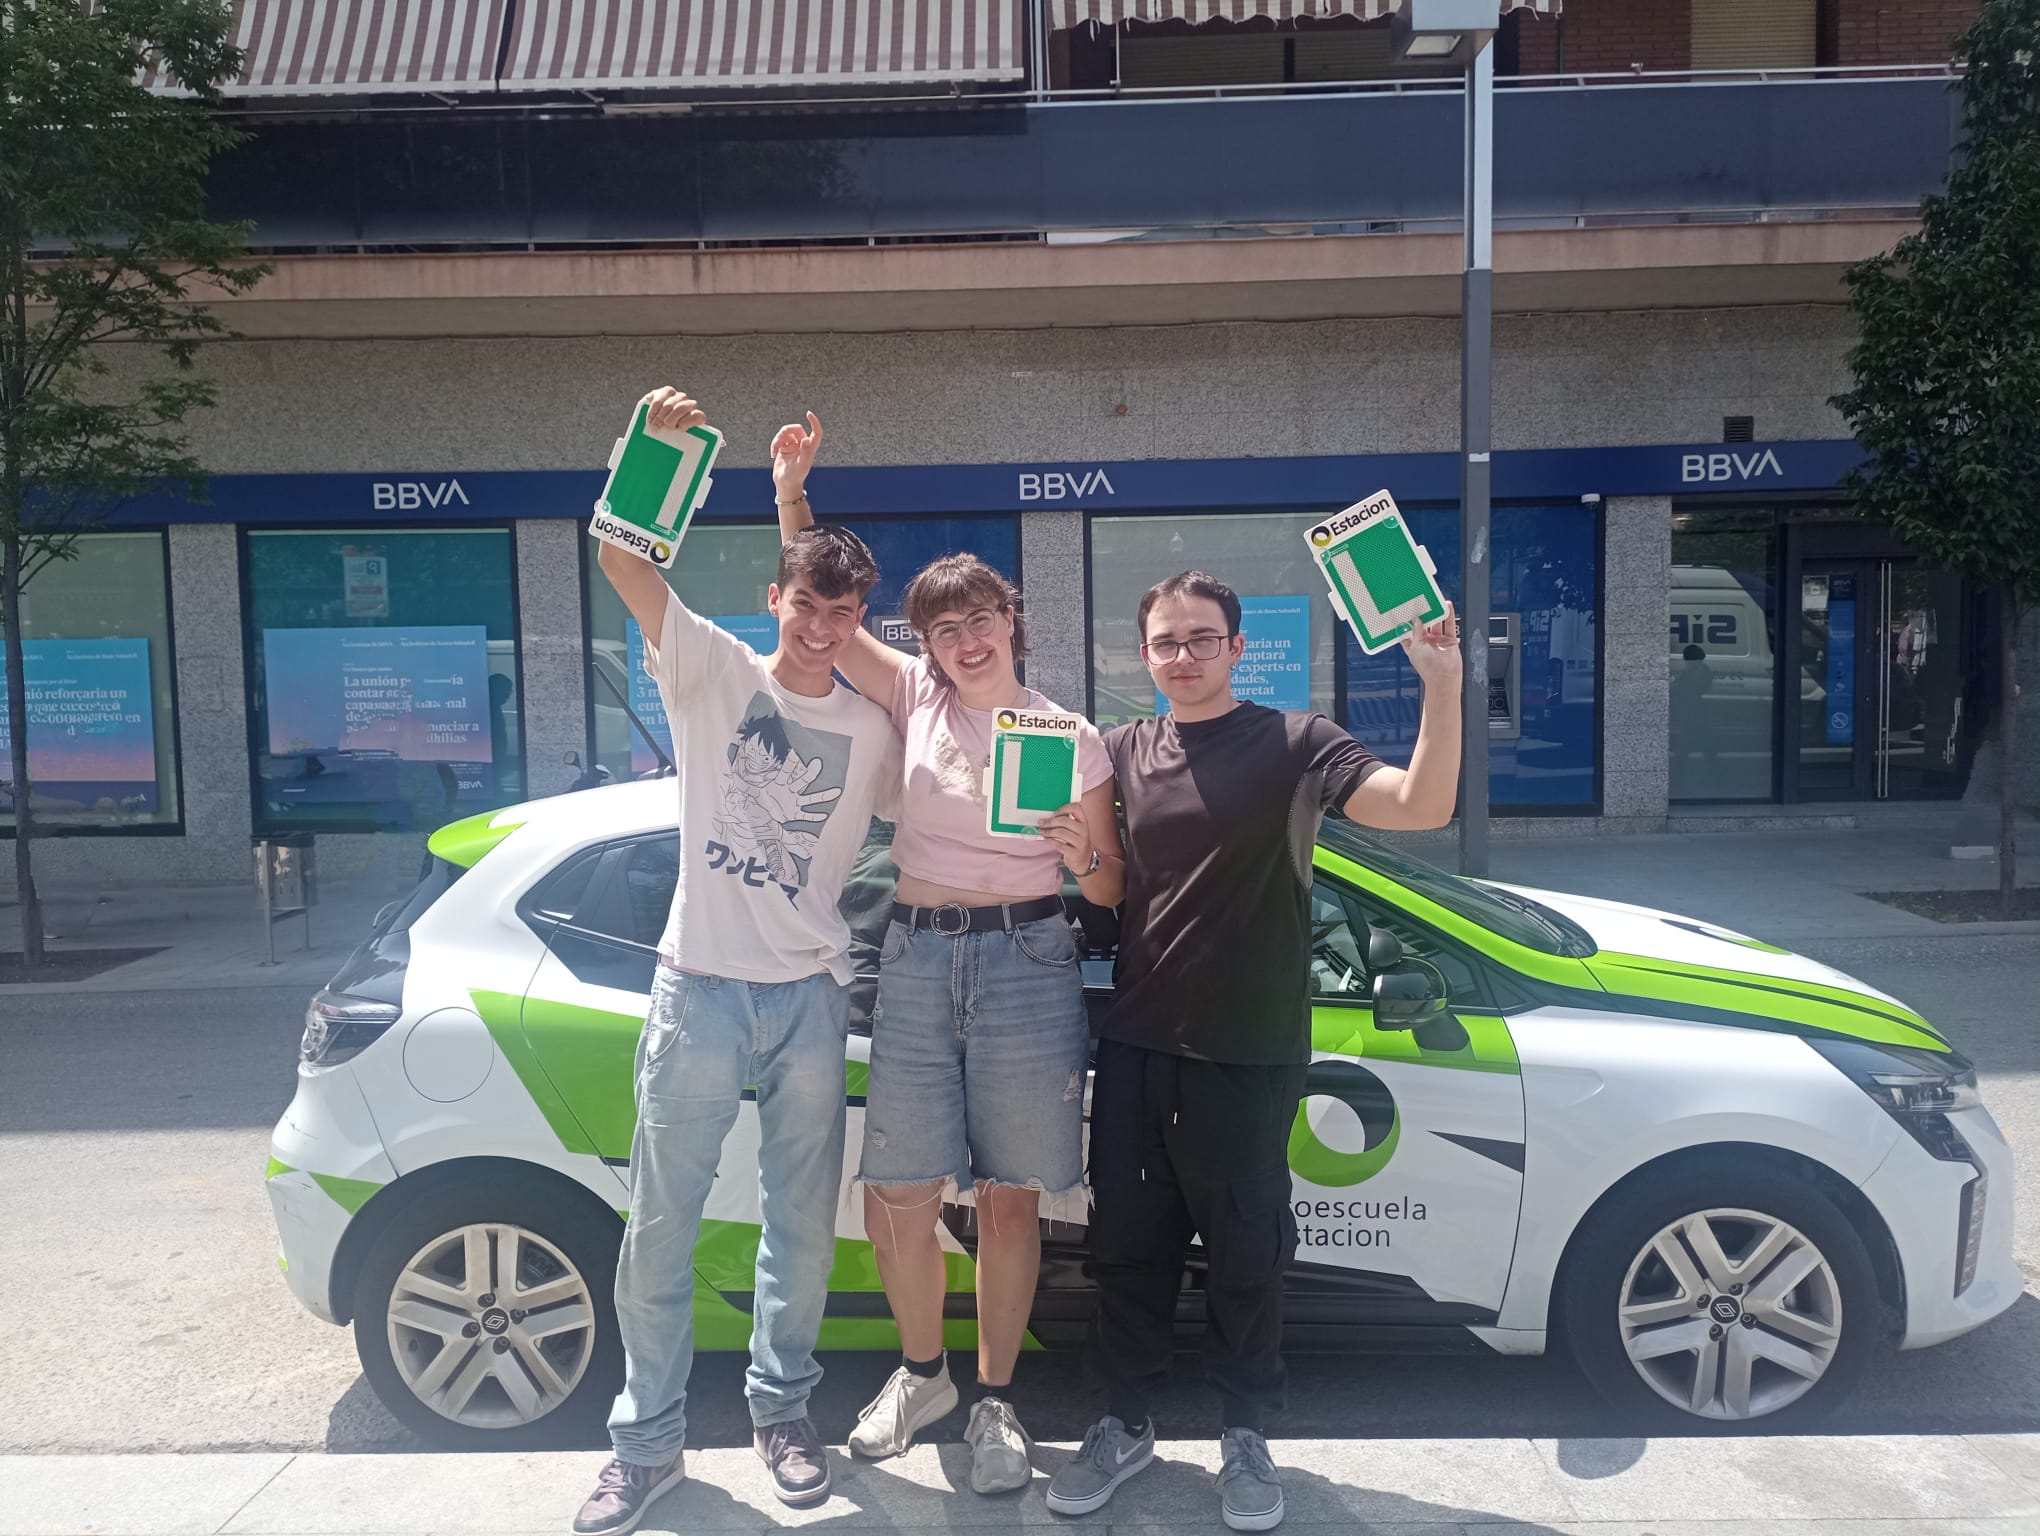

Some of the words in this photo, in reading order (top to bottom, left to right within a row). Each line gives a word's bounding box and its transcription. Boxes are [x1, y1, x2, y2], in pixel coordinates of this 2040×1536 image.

[1682, 448, 1783, 482] BBVA
[1019, 468, 1115, 500] BBVA
[373, 479, 470, 510] BBVA
[1330, 499, 1391, 536] Estacion
[595, 517, 651, 554] Estacion
[886, 625, 912, 641] BB
[1275, 639, 1291, 648] un
[1239, 664, 1284, 675] experts
[1287, 662, 1301, 672] en
[344, 676, 359, 688] La
[362, 674, 398, 688] unión
[25, 688, 43, 700] nió
[110, 689, 128, 699] un
[344, 688, 385, 699] contar
[1230, 686, 1275, 699] guretat
[1018, 714, 1077, 731] Estacion
[1293, 1195, 1427, 1221] oescuela
[1295, 1221, 1391, 1247] tacion
